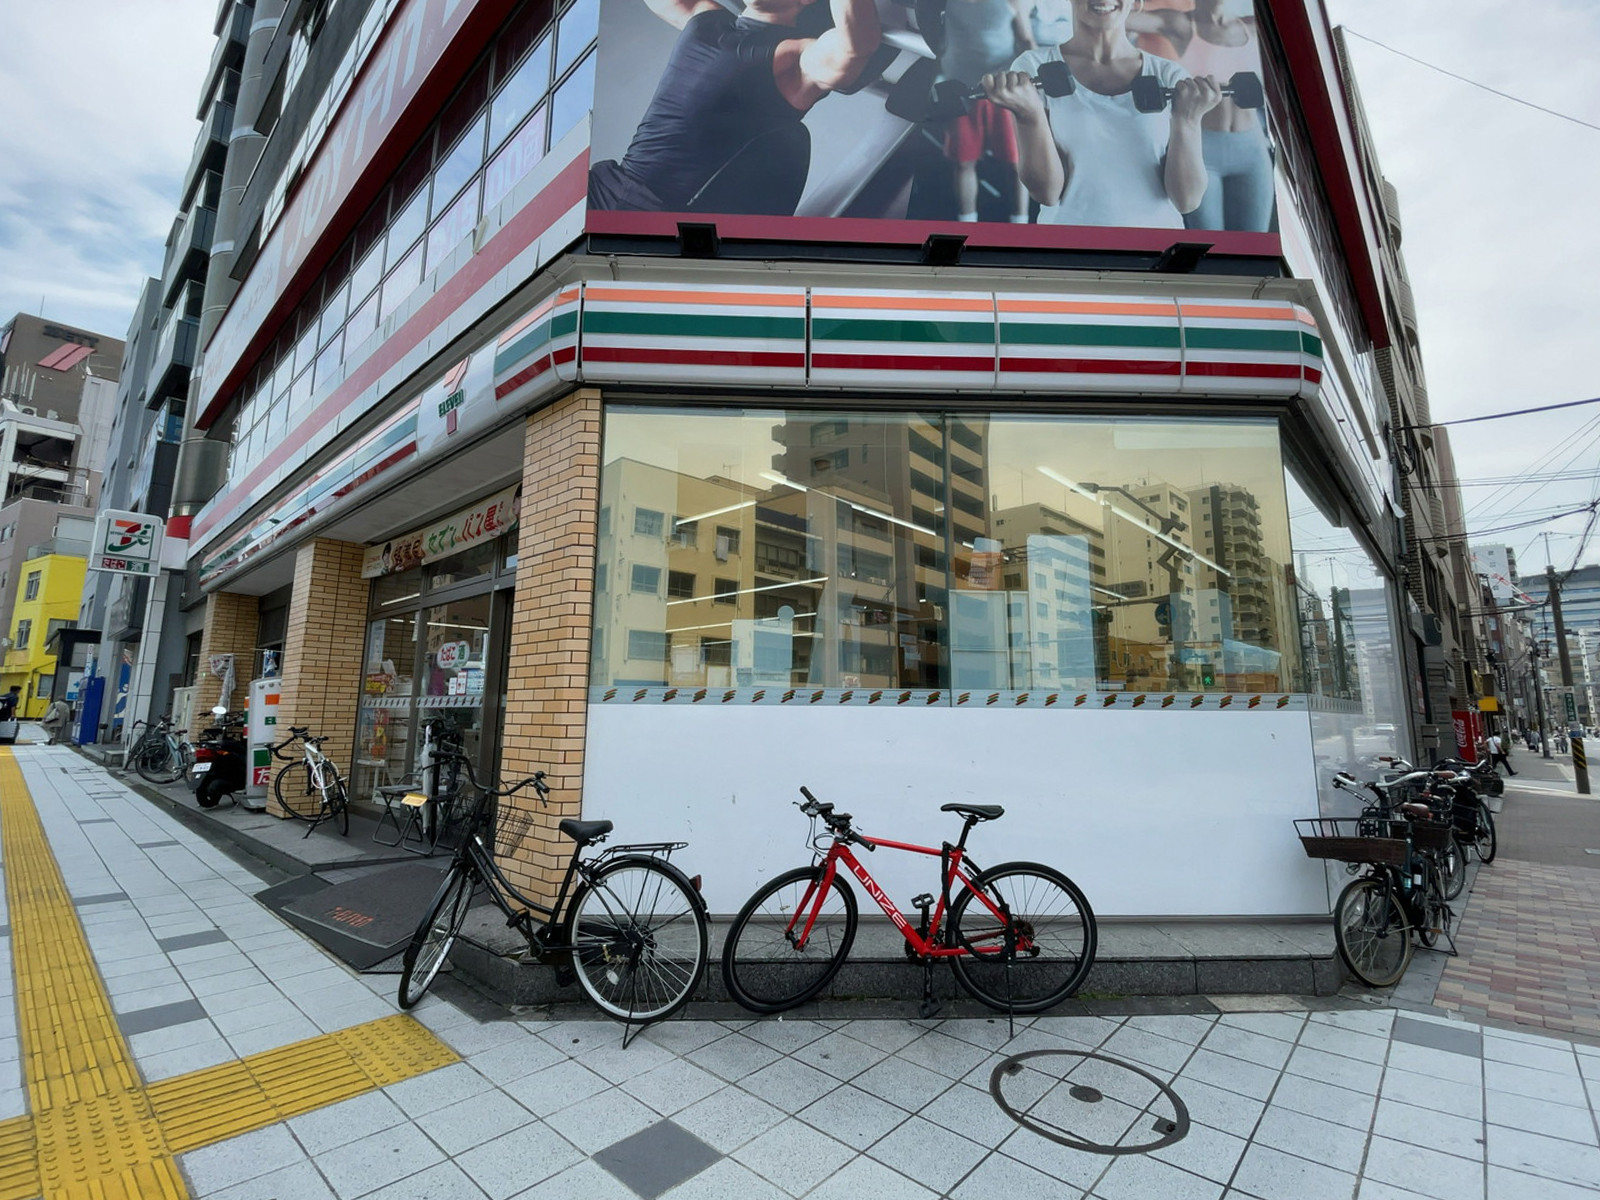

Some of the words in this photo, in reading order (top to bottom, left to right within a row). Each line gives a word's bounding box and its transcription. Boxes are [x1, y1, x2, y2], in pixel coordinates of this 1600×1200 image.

[441, 646, 455, 661] たばこ
[853, 865, 907, 929] UNIZE
